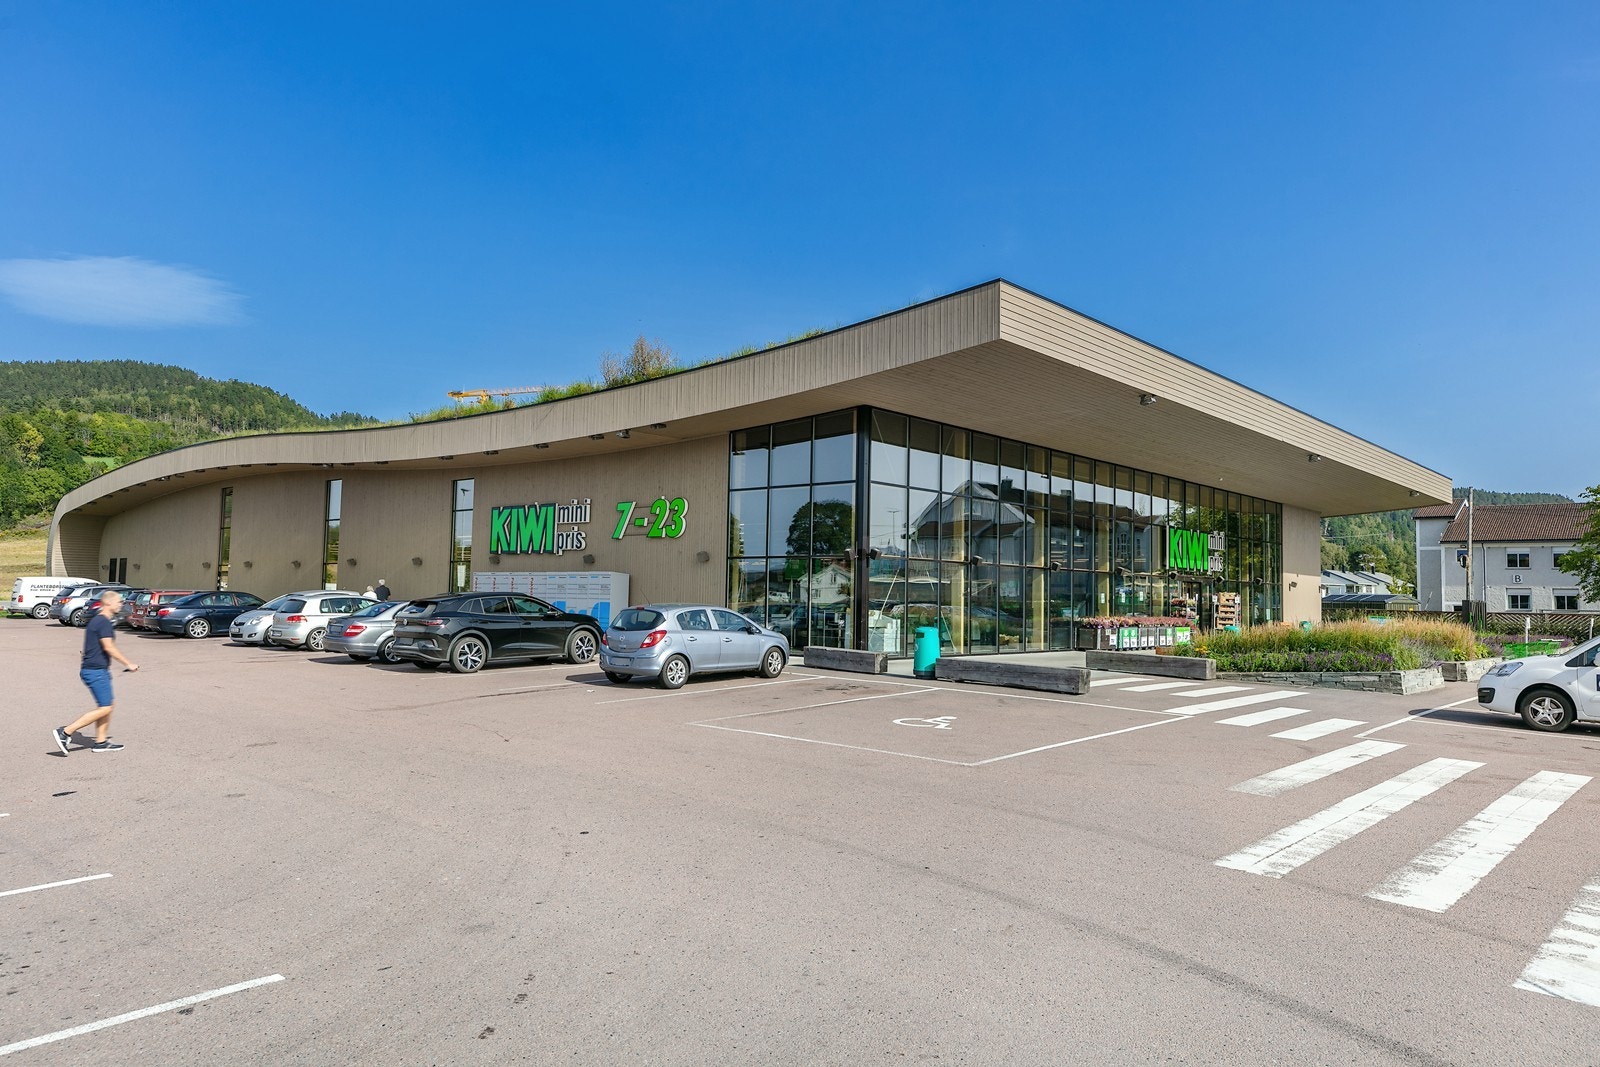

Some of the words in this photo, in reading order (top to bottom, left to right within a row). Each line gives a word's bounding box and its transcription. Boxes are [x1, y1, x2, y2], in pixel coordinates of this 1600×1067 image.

[490, 503, 556, 554] KIWI
[557, 498, 590, 523] mini
[612, 496, 688, 540] 7-23
[556, 526, 586, 555] pris
[1168, 526, 1208, 572] KIWI
[1514, 574, 1522, 582] B
